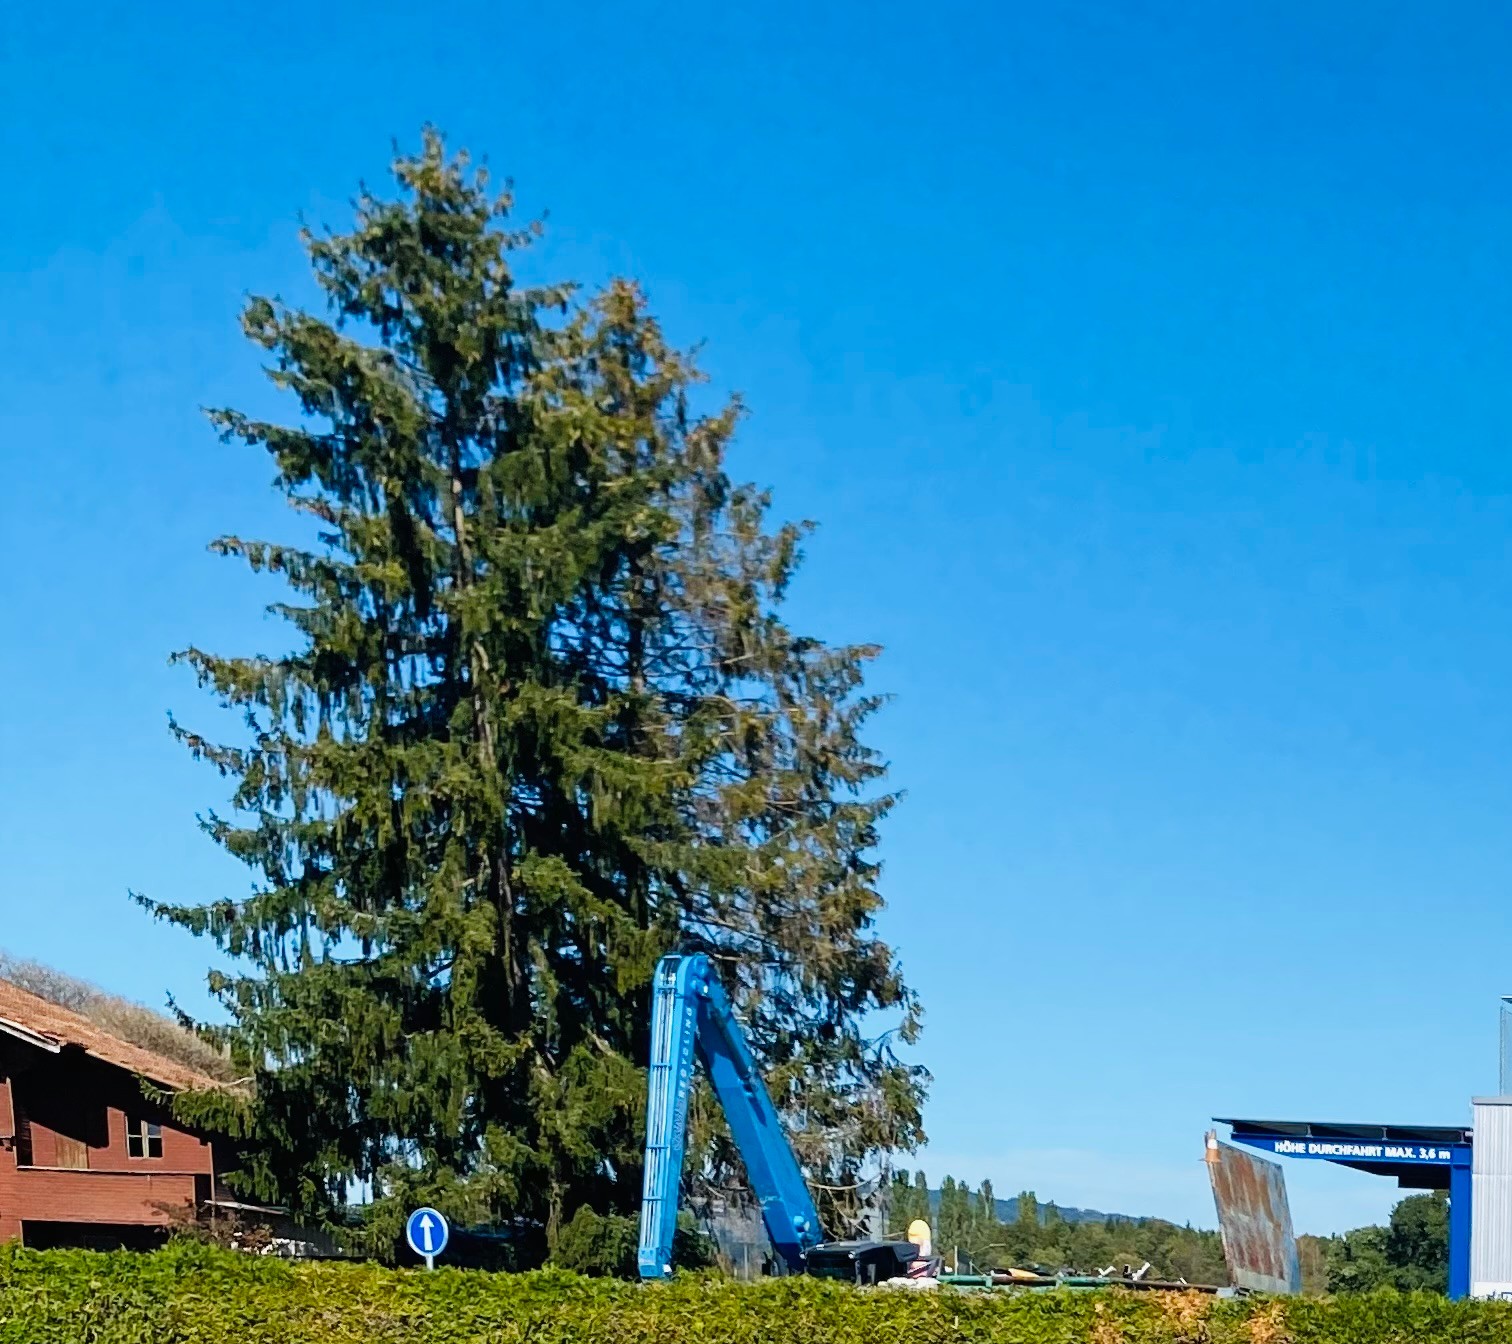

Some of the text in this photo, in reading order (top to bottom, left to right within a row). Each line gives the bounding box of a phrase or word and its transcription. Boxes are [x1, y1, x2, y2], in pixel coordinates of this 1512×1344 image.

[1274, 1140, 1306, 1154] HÖHE
[1308, 1143, 1382, 1158] DURCHFAHRT
[1384, 1146, 1417, 1159] MAX.
[1438, 1150, 1451, 1160] m
